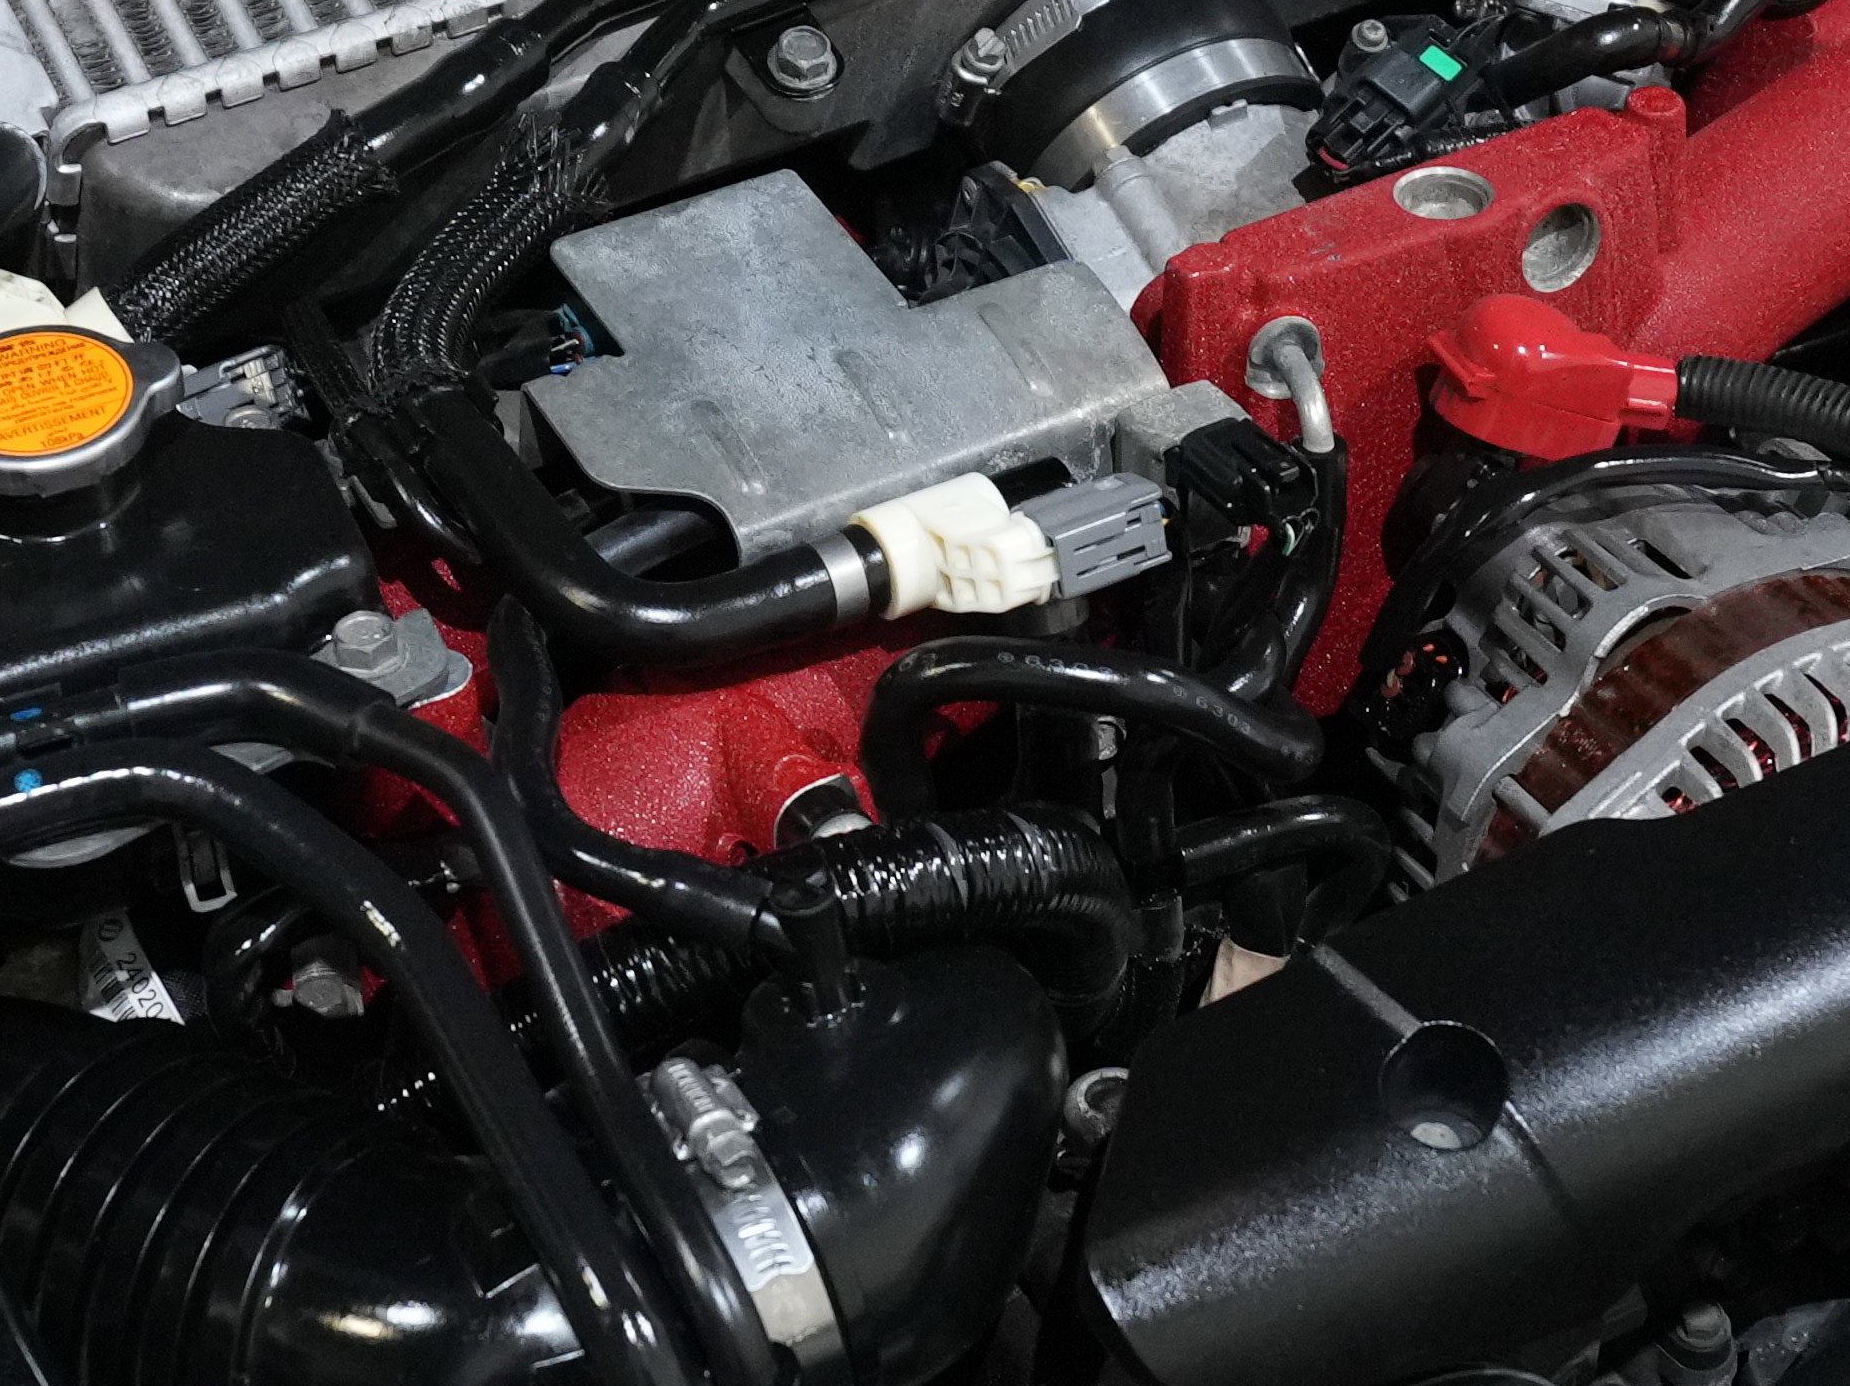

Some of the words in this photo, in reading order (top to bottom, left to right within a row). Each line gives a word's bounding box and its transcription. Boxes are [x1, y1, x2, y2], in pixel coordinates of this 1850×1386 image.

[2, 381, 35, 400] OPEN
[40, 371, 77, 389] WHEN
[81, 363, 106, 376] HOT
